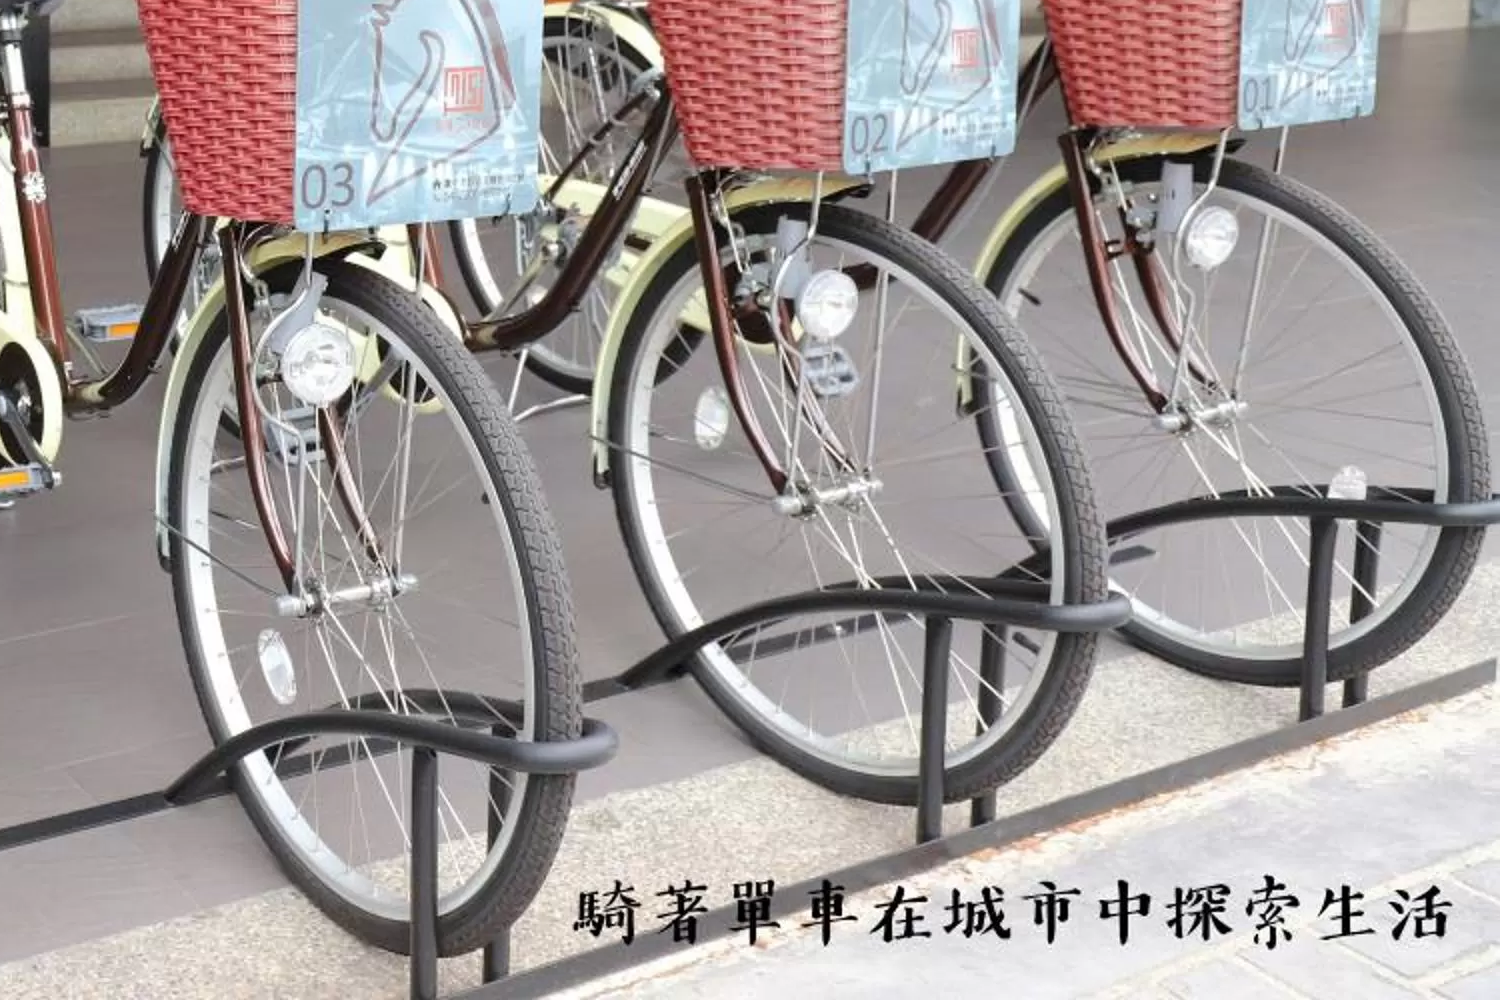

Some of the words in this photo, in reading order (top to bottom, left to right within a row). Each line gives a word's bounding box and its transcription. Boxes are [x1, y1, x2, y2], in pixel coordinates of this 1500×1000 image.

[1244, 77, 1275, 113] 01
[851, 114, 889, 154] 02
[301, 161, 355, 209] 03
